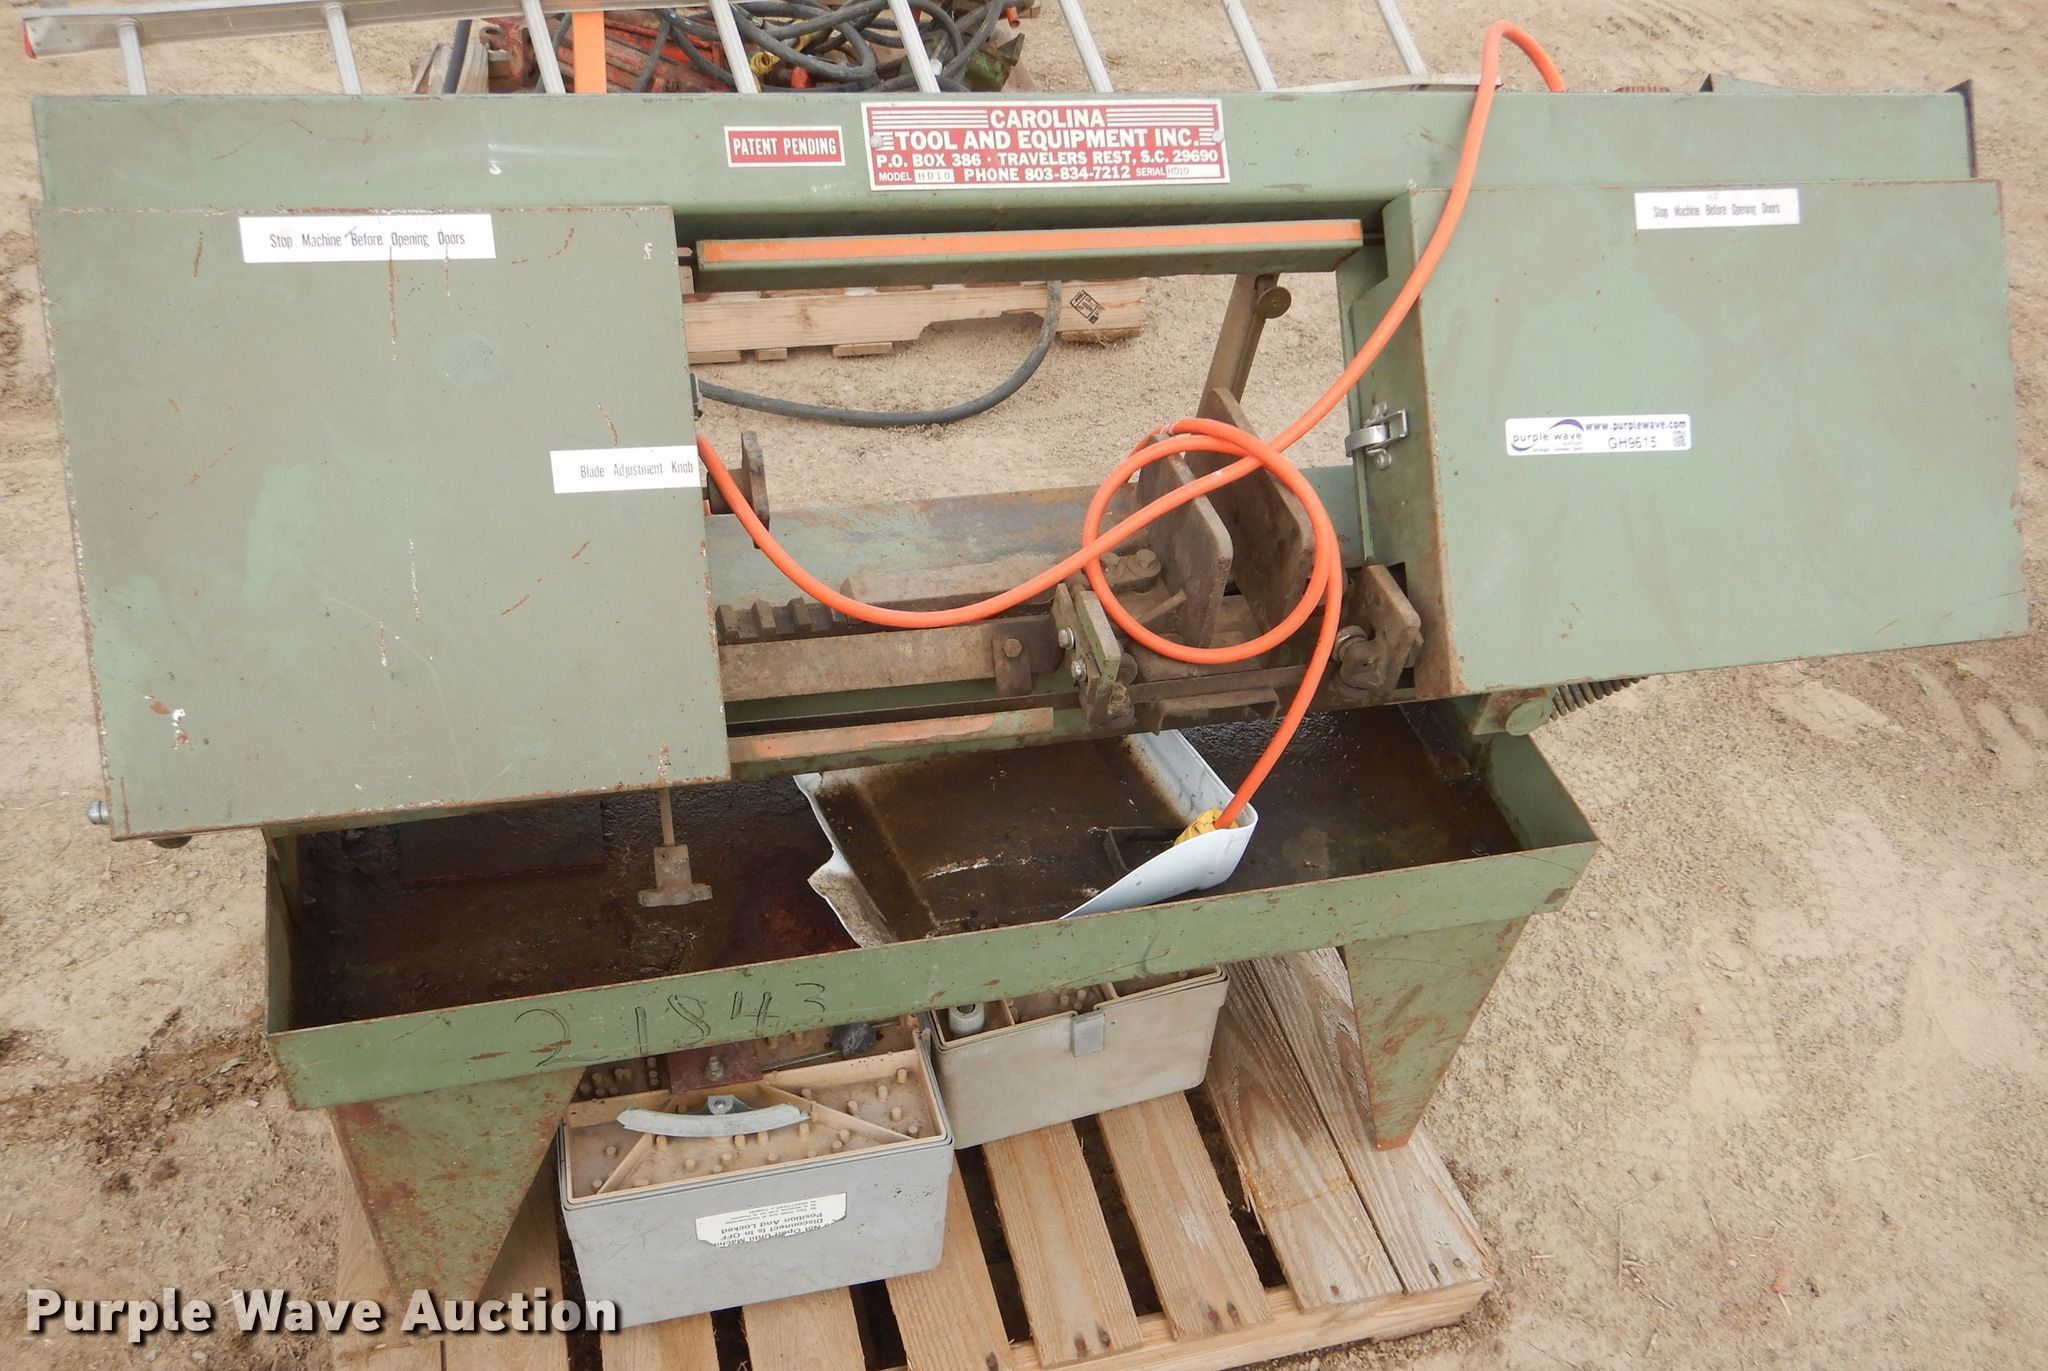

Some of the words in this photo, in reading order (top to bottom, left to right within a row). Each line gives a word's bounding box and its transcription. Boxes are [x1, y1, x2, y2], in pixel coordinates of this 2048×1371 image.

[990, 108, 1106, 129] CAROLINA
[733, 137, 777, 156] PATENT
[783, 137, 837, 156] PENDING
[894, 130, 959, 150] TOOL
[963, 129, 1012, 149] AND
[1017, 128, 1148, 151] EQUIPMENT
[1155, 127, 1199, 147] INC.
[875, 155, 908, 168] P.O.
[912, 153, 947, 167] BOX
[951, 152, 982, 167] 386
[997, 151, 1088, 166] TRAVELERS
[1092, 150, 1137, 166] REST,
[1140, 149, 1169, 163] S.C.
[1172, 149, 1219, 163] 29690
[878, 171, 912, 182] MODEL
[963, 168, 1020, 182] PHONE
[1024, 165, 1131, 181] 803-834-7212
[1135, 166, 1166, 177] SERIAL
[1653, 205, 1669, 218] Stop
[1674, 205, 1700, 217] Machine
[1705, 203, 1727, 216] Before
[1732, 203, 1757, 216] Opening
[1761, 202, 1781, 214] Doors
[269, 234, 293, 249] Stop
[301, 232, 343, 247] Machine
[350, 231, 383, 247] Before
[390, 231, 430, 248] Opening
[437, 230, 466, 246] Doors
[1585, 419, 1687, 432] www.purplewave.com
[1513, 431, 1549, 443] purple
[1553, 432, 1582, 440] wave
[1608, 437, 1658, 449] GH9615
[579, 465, 605, 479] Blade
[613, 462, 664, 479] Adjustment
[671, 460, 694, 474] Knob
[769, 1218, 823, 1232] Disconnect
[784, 1213, 823, 1223] Position
[721, 1223, 757, 1234] Locked
